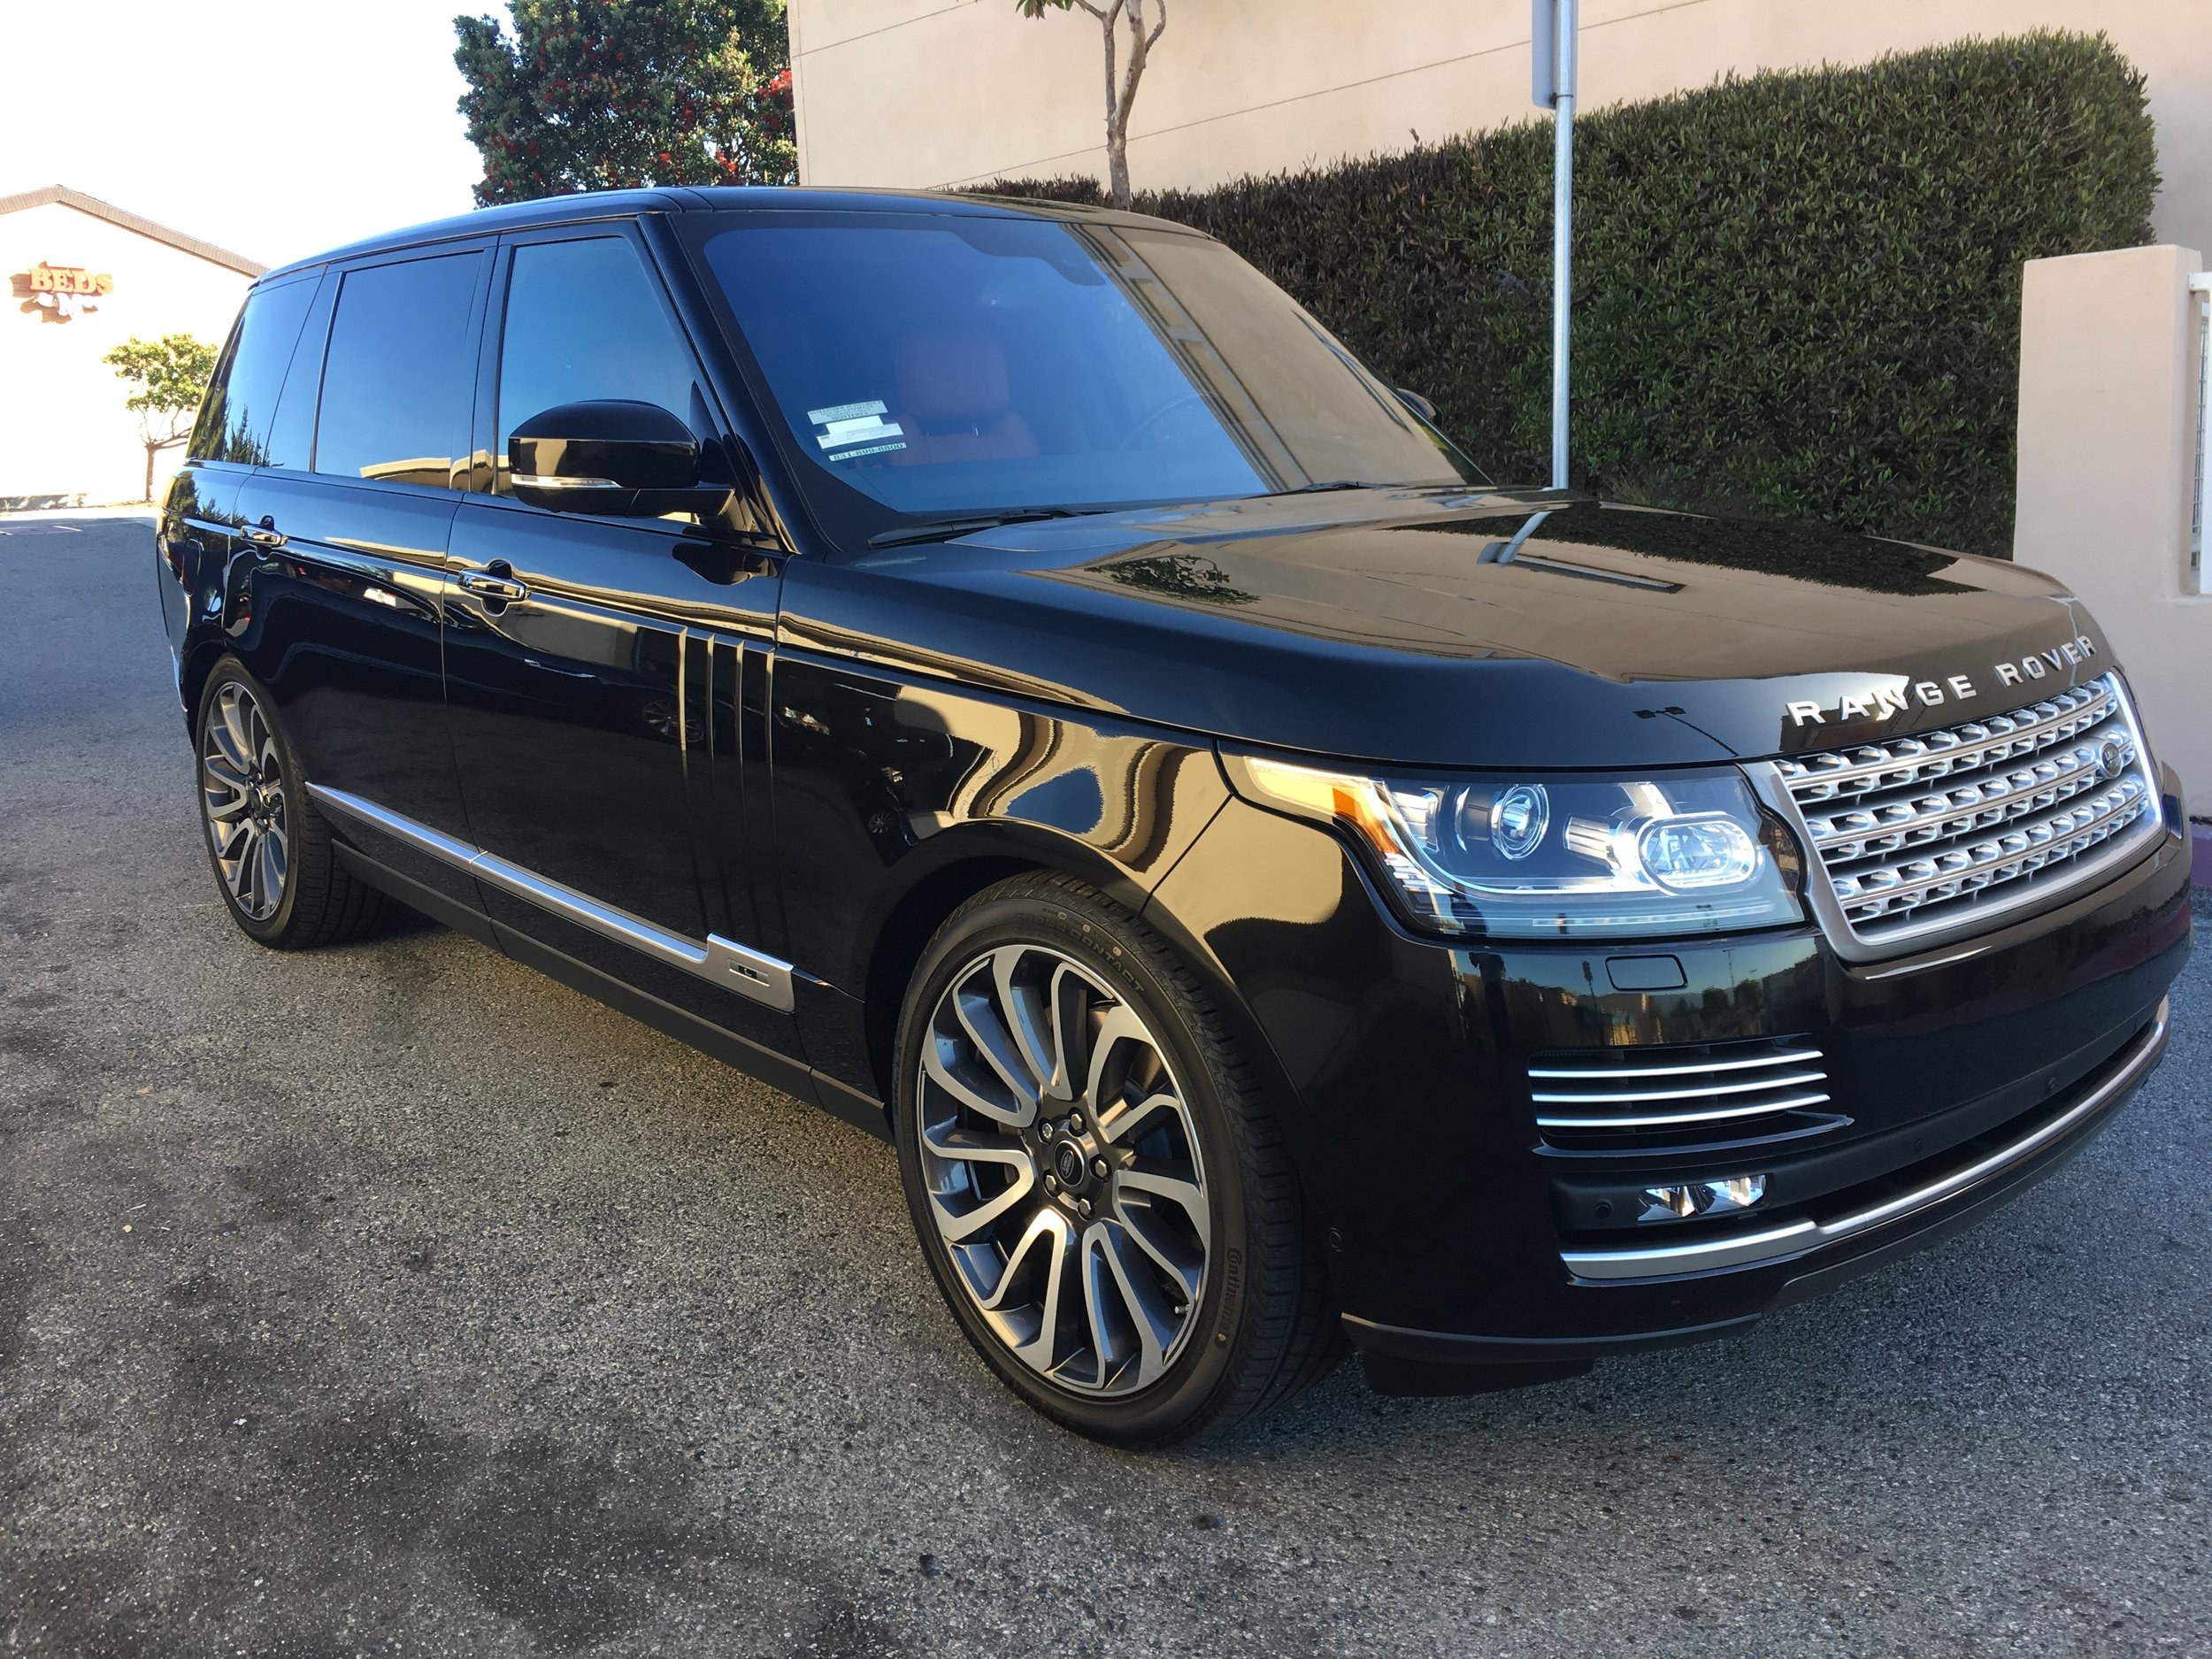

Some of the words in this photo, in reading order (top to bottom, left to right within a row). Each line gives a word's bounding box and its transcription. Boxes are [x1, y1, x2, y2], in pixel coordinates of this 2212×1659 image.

[28, 268, 113, 295] BEDS
[832, 411, 869, 420] MONTEREY
[1786, 675, 1977, 726] RANGE
[1994, 635, 2096, 687] ROVER
